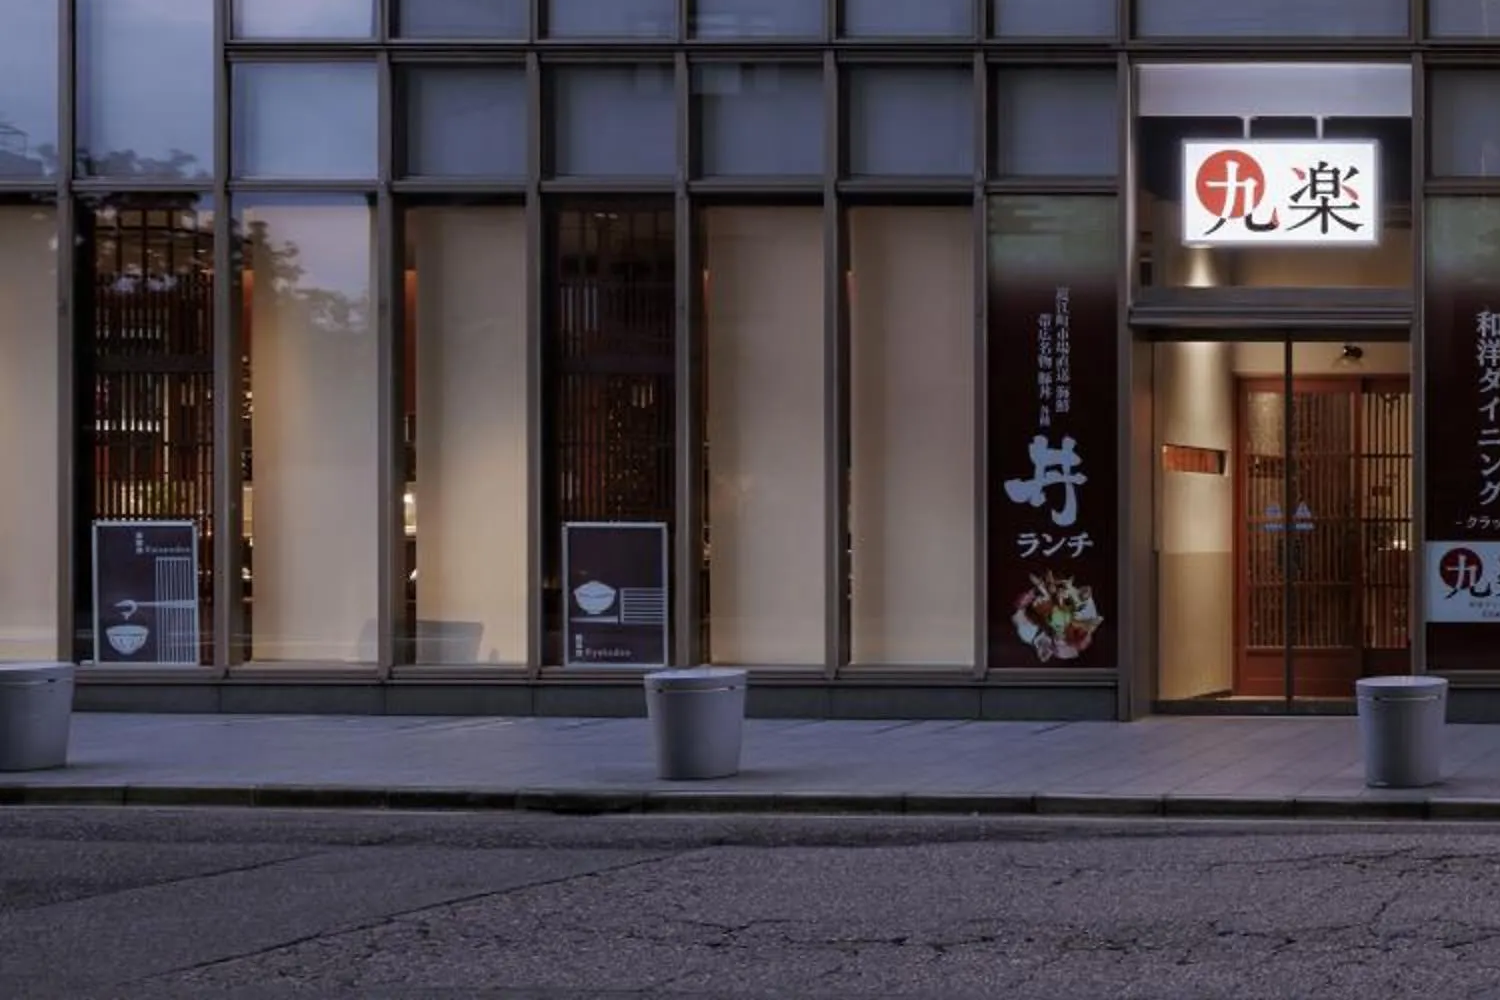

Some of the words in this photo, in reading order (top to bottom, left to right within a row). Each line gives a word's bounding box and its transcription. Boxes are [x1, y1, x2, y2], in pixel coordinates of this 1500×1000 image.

[1203, 159, 1365, 237] 九楽
[1017, 532, 1094, 558] ランチ
